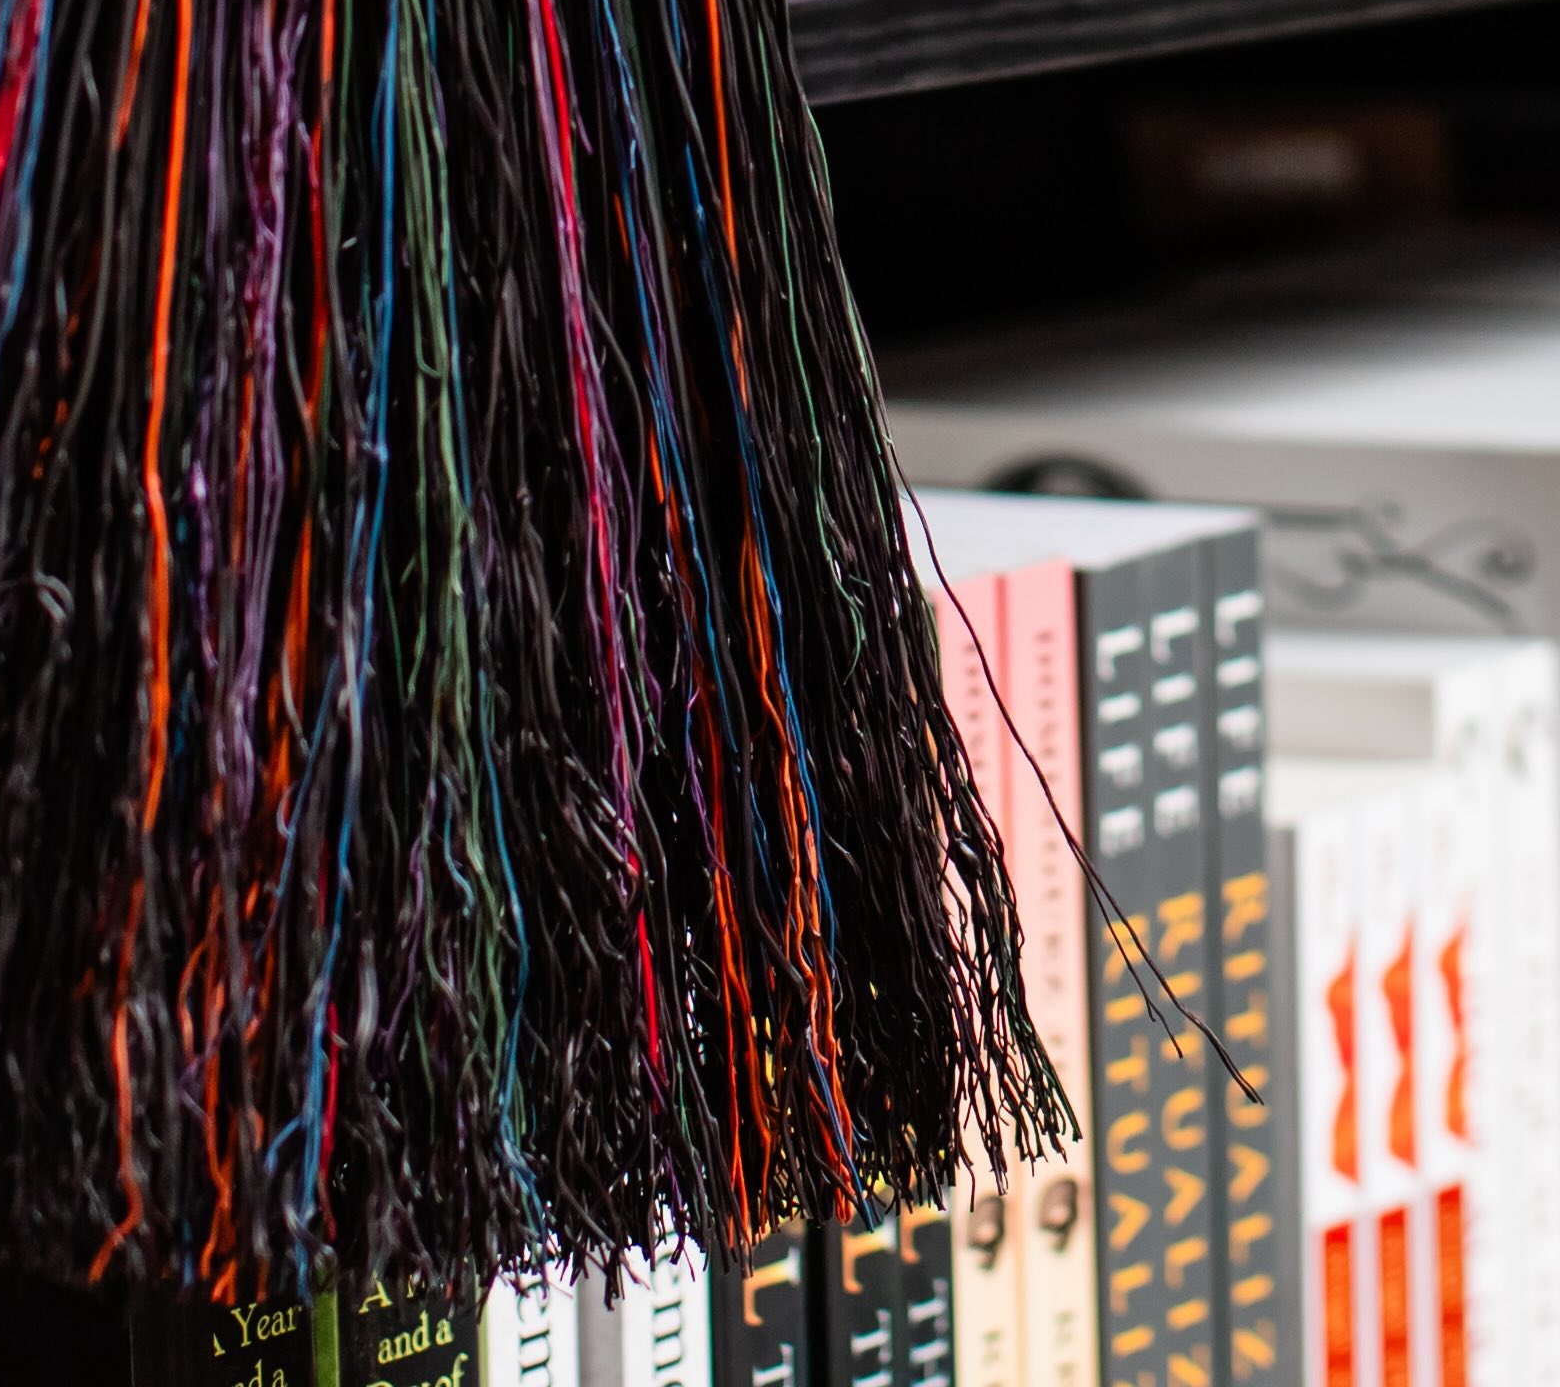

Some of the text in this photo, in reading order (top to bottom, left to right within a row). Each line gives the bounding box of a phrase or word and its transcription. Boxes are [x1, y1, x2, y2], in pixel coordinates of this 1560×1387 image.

[1095, 623, 1147, 857] LIFE
[1149, 605, 1201, 837] LIFE
[1213, 589, 1266, 826] LIFE
[231, 1302, 303, 1349] Year
[378, 1309, 456, 1365] and a
